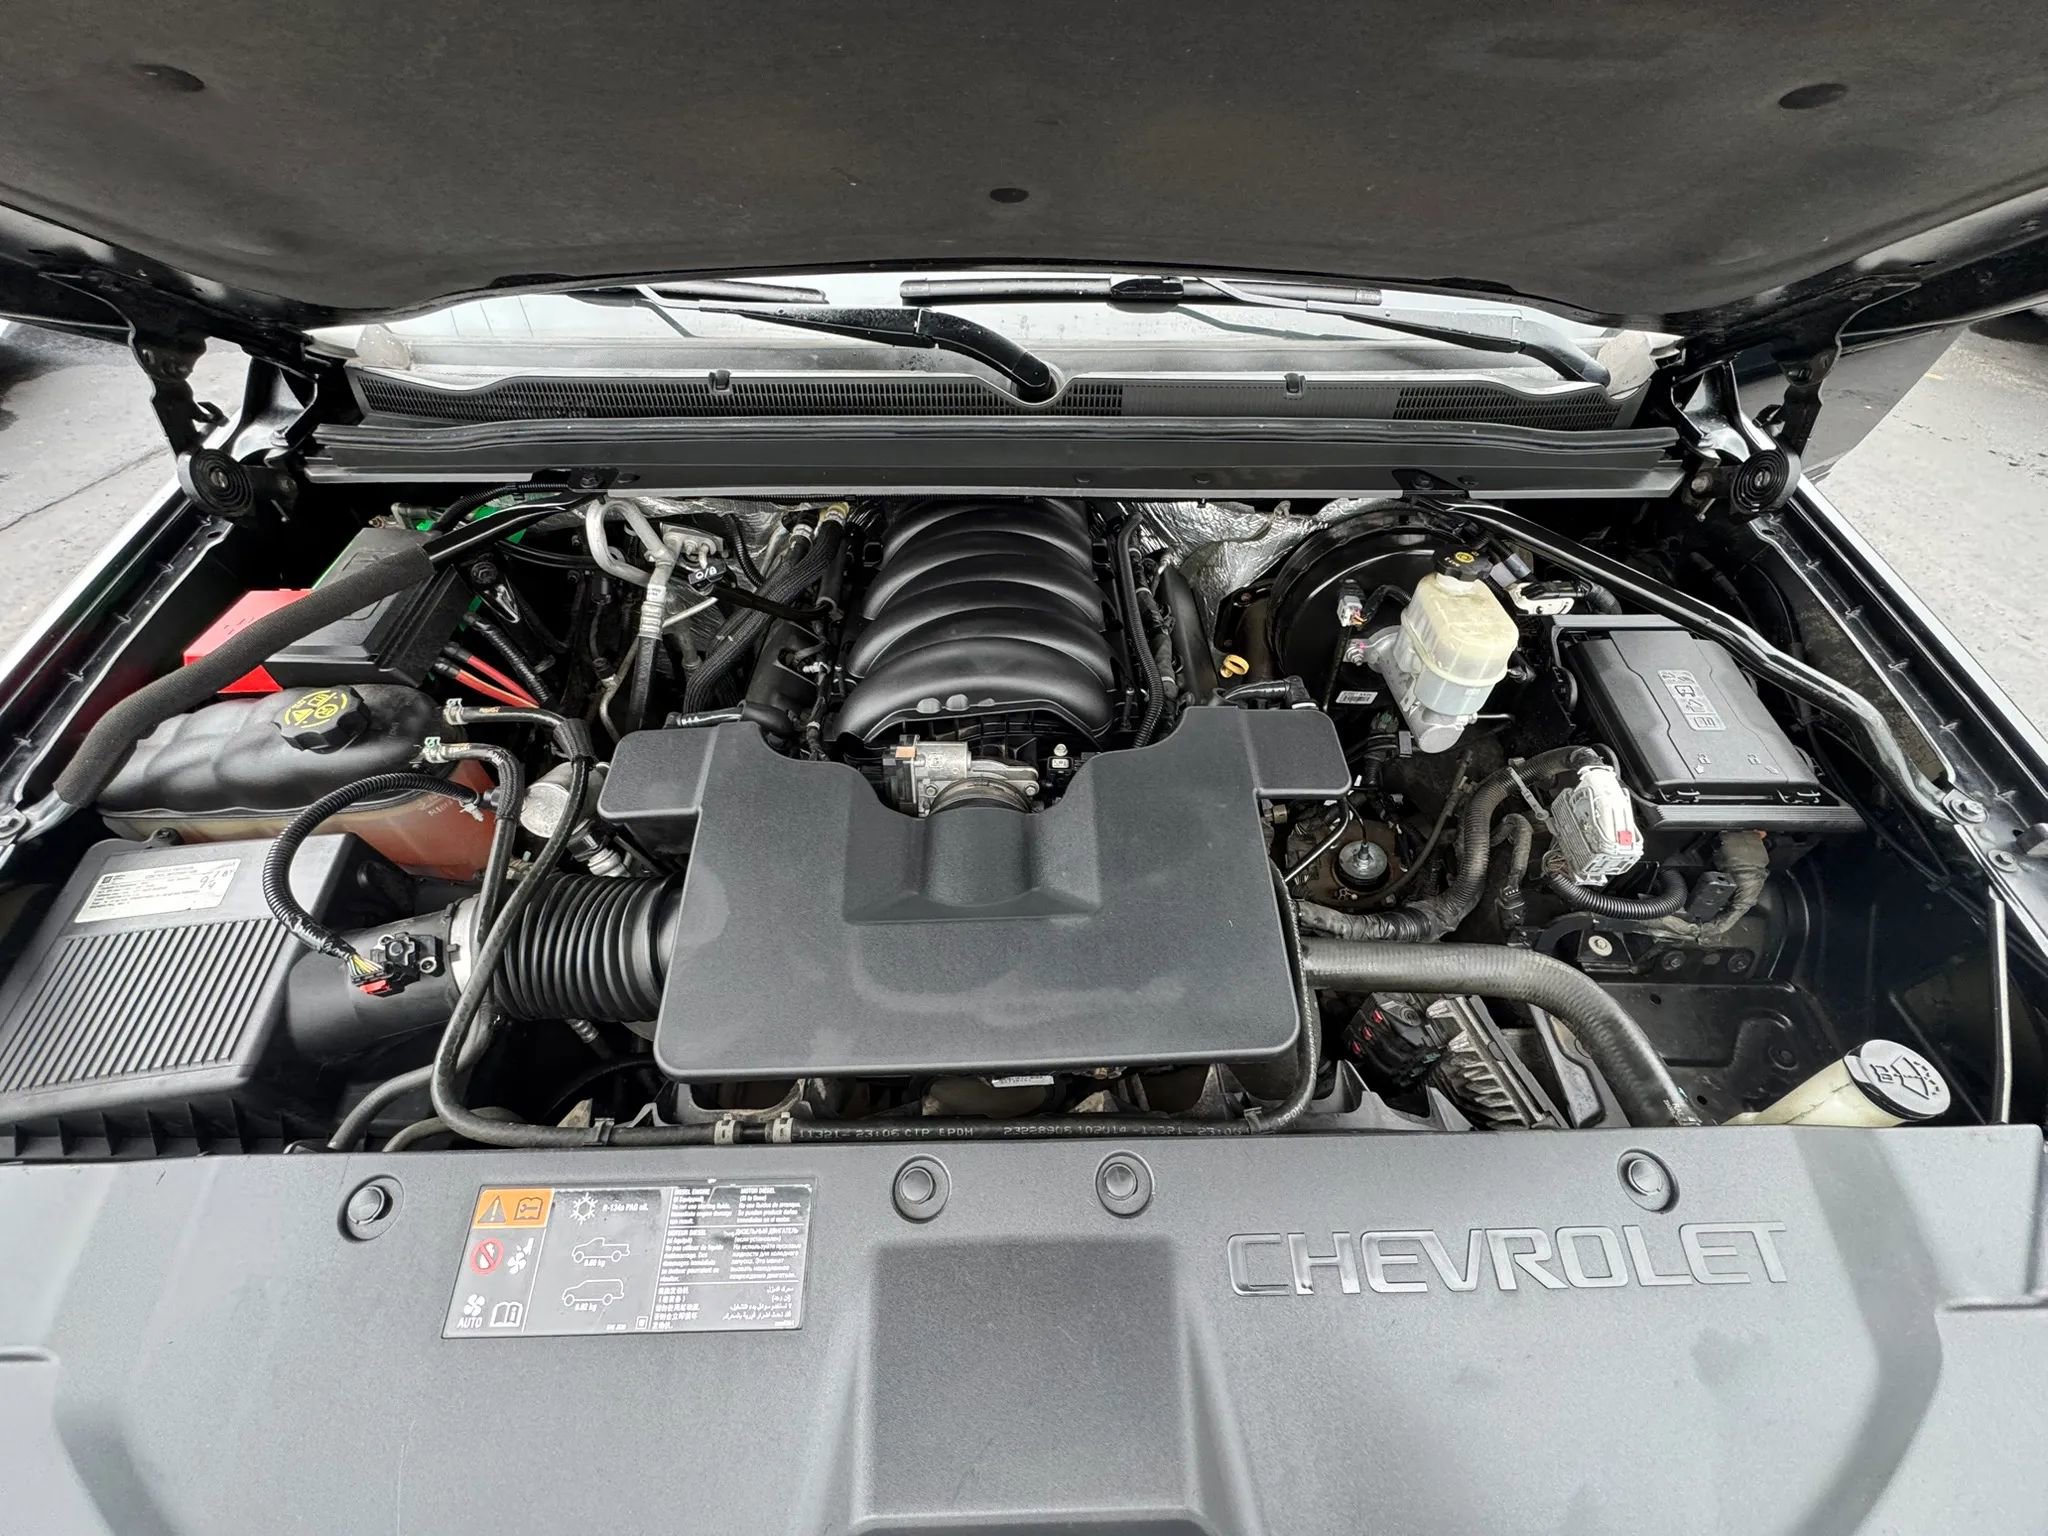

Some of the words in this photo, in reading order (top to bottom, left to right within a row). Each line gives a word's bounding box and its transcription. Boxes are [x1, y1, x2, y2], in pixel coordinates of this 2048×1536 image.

[1277, 1103, 1304, 1127] EPDM
[939, 1127, 974, 1136] EPDM
[1227, 1222, 1788, 1297] CHEVROLET
[457, 1316, 483, 1329] AUTO
